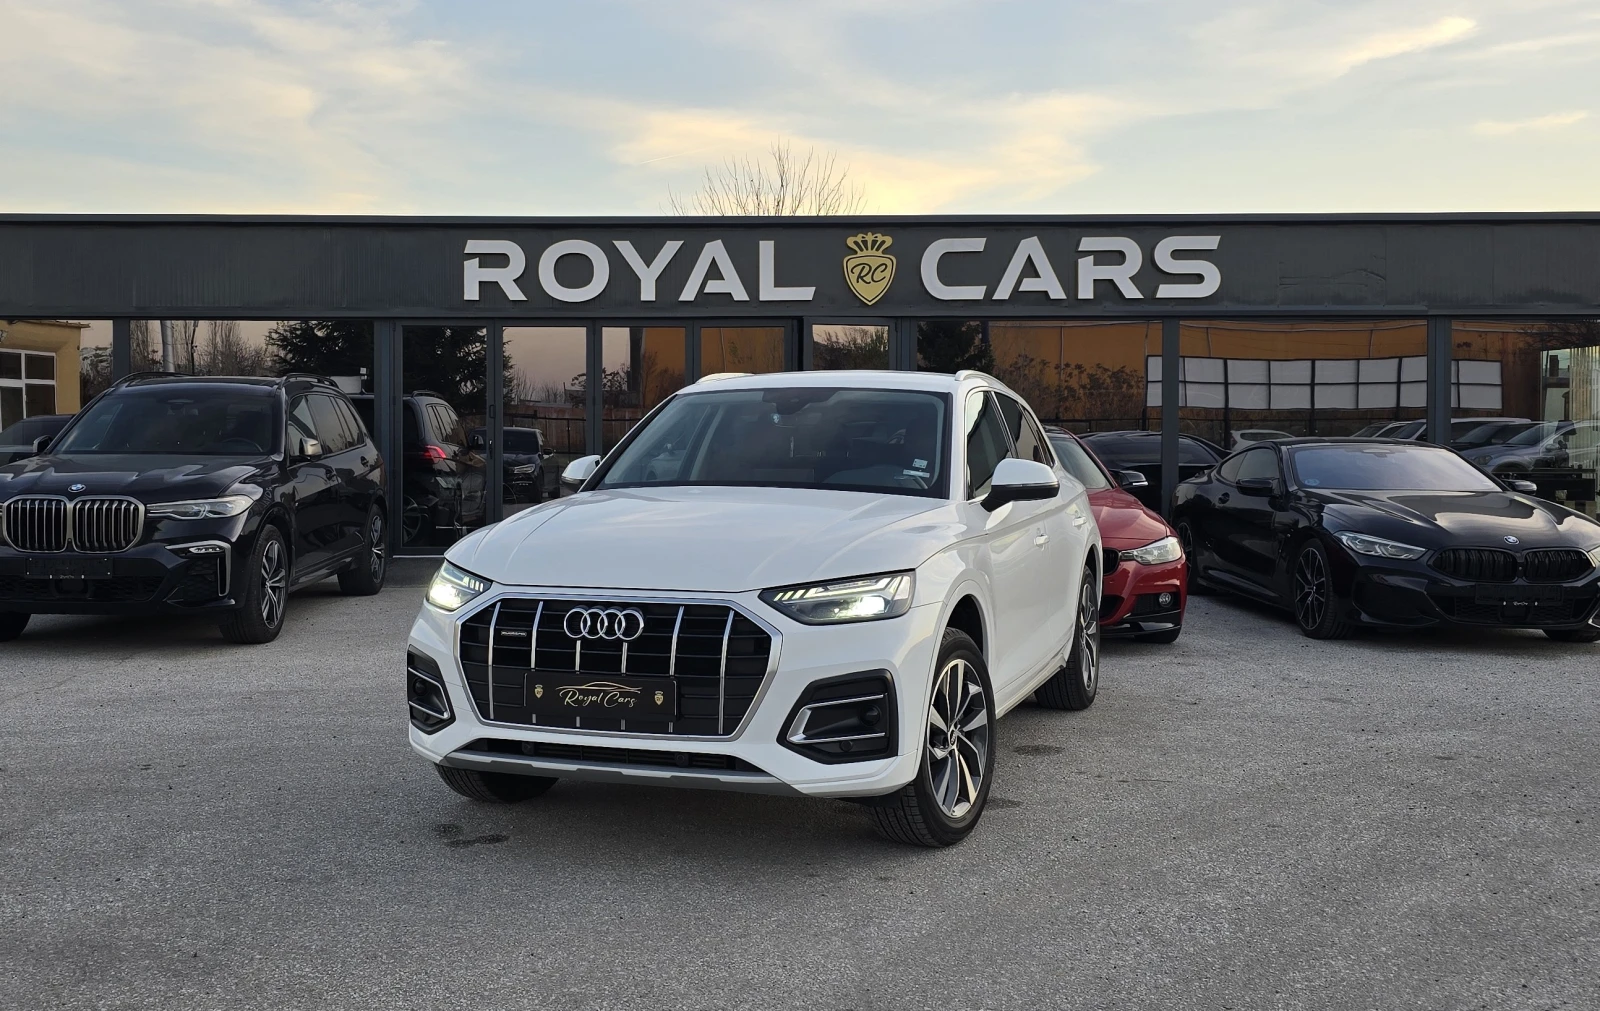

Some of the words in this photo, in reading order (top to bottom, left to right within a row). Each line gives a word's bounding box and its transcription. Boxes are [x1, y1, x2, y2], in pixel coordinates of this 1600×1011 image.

[463, 239, 817, 303] ROYAL
[920, 236, 1222, 301] CARS
[850, 262, 888, 285] RC
[559, 688, 604, 707] Royal
[603, 691, 637, 708] Cars
